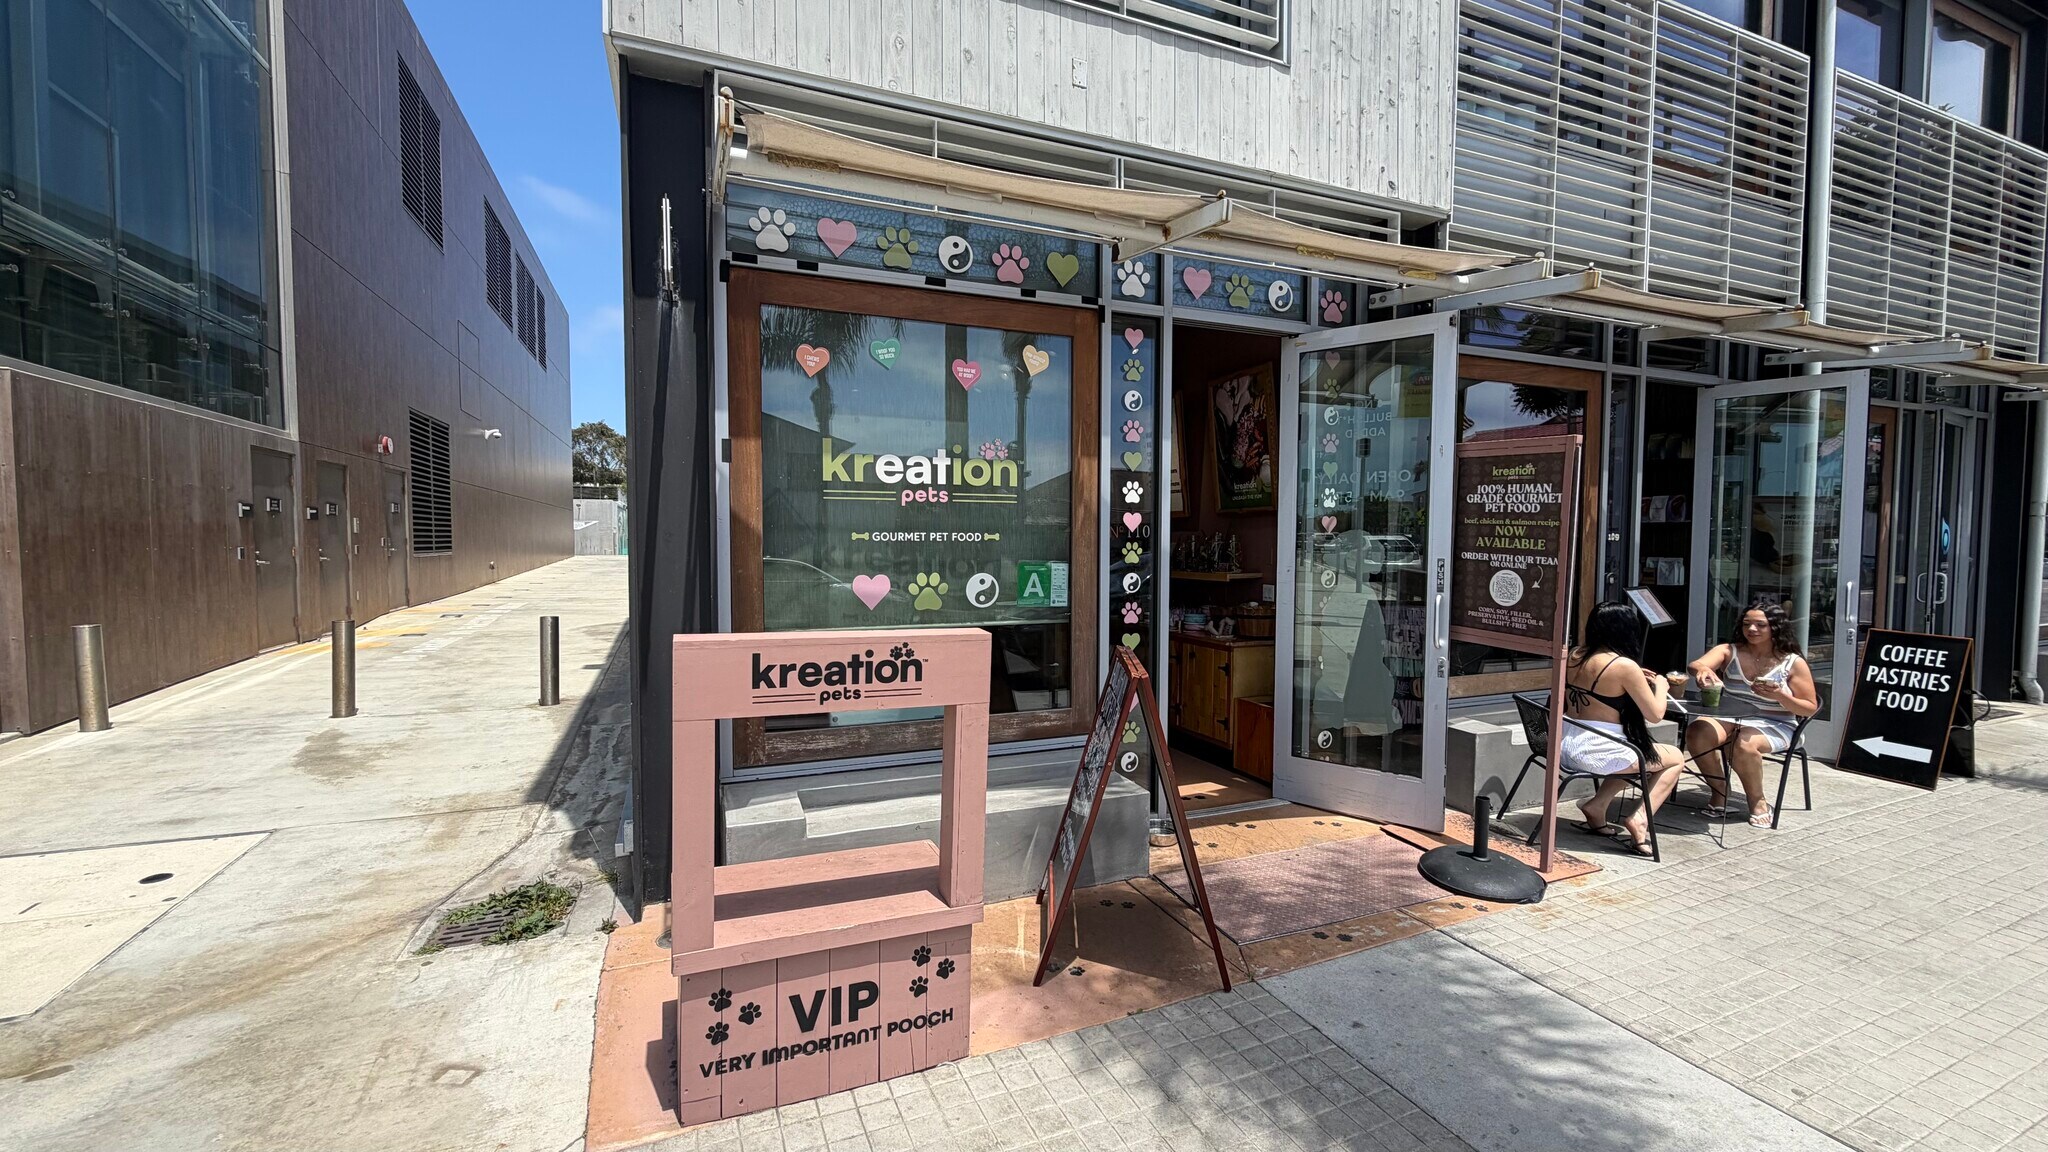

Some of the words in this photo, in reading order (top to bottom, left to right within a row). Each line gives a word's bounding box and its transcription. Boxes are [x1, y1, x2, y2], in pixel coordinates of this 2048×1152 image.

[822, 438, 1018, 488] kreation
[1492, 464, 1535, 476] kreation
[901, 487, 948, 506] pets
[1477, 484, 1506, 494] 100%
[1508, 483, 1552, 494] HUMAN
[1466, 494, 1503, 503] GRADE
[1505, 493, 1563, 504] GOURMET
[1485, 503, 1506, 513] PET
[1508, 503, 1540, 513] FOOD
[872, 532, 926, 542] GOURMET
[930, 532, 948, 542] PET
[952, 532, 982, 542] FOOD
[1495, 525, 1526, 536] NOW
[1476, 537, 1546, 550] AVAILABLE
[1461, 552, 1489, 561] ORDER
[1490, 553, 1514, 562] WITH
[1515, 555, 1534, 564] OUR
[1023, 572, 1044, 597] A
[1880, 644, 1949, 668] COFFEE
[752, 649, 922, 689] kreation
[1866, 665, 1952, 692] PASTRIES
[820, 687, 861, 705] pets
[1876, 690, 1928, 712] FOOD
[788, 980, 879, 1034] VIP
[700, 1052, 756, 1078] VERY
[762, 1025, 882, 1066] IMPORTANT
[887, 1007, 954, 1037] POOCH
